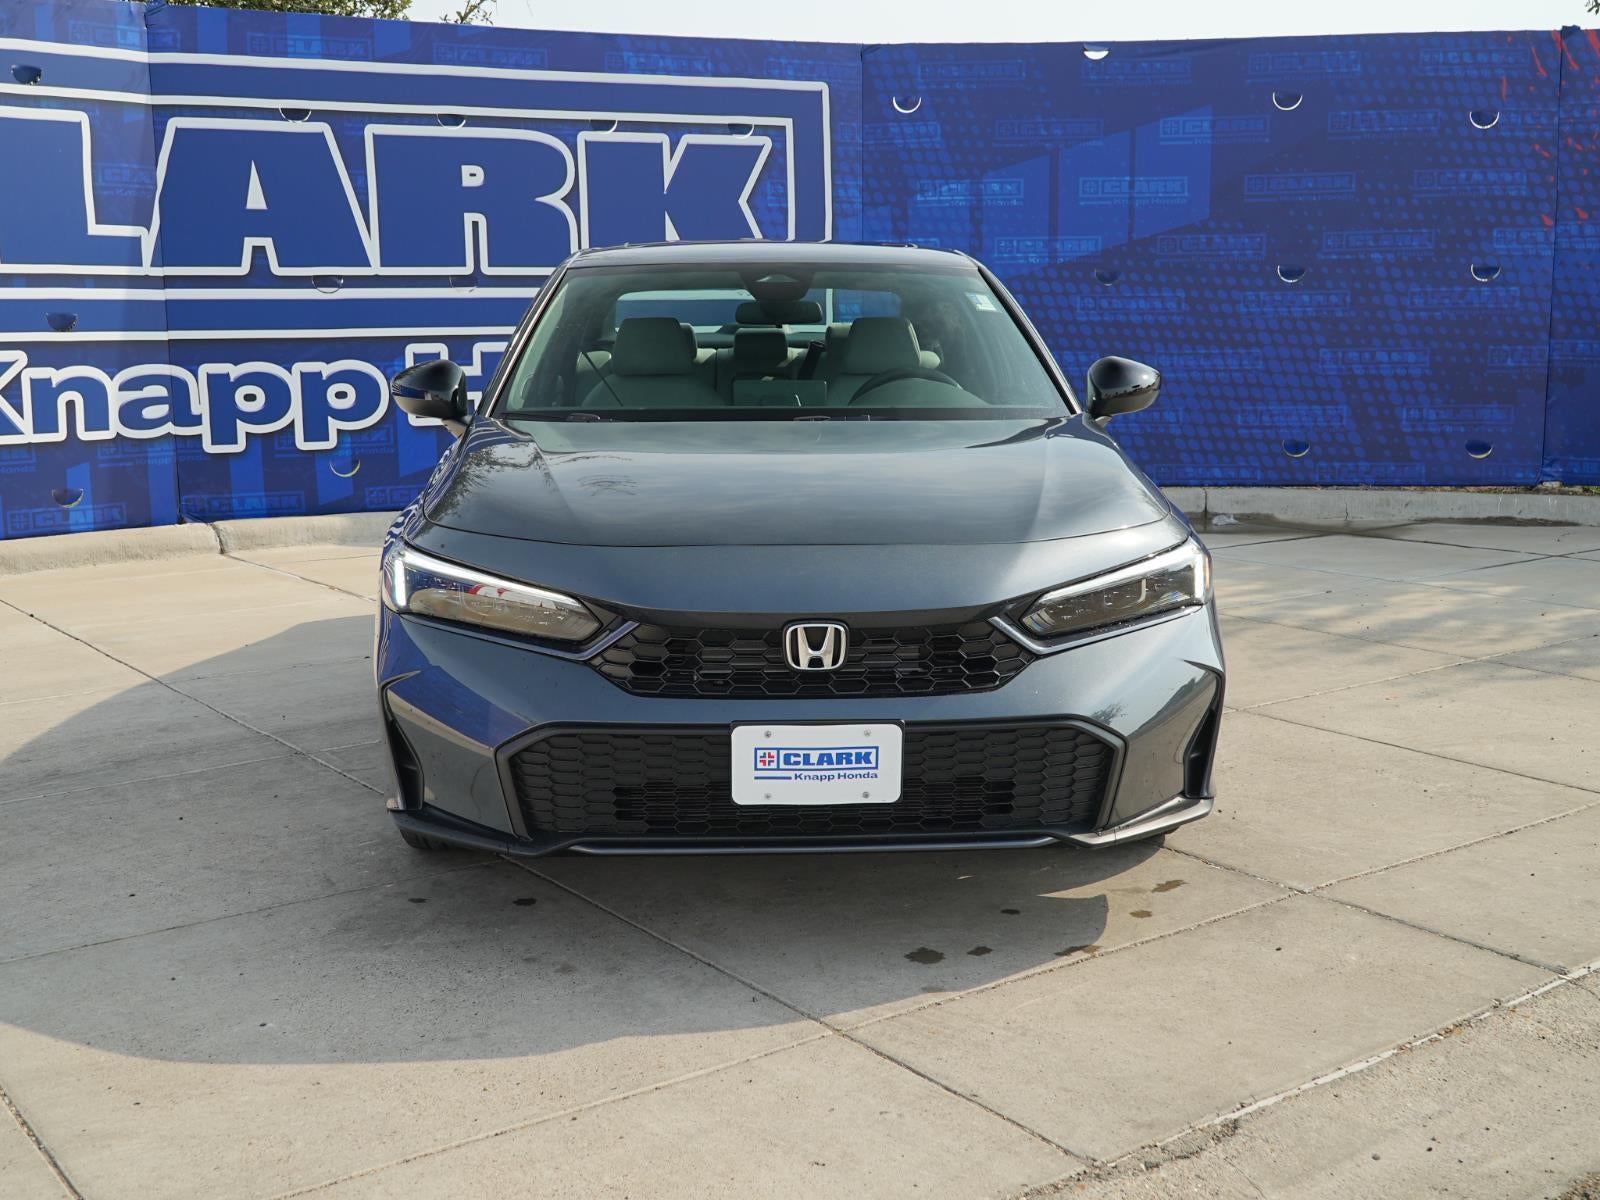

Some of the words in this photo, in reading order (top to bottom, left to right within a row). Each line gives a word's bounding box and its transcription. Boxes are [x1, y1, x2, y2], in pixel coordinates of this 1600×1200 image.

[783, 751, 873, 766] CLARK
[794, 773, 835, 782] Knapp
[837, 772, 878, 780] Honda
